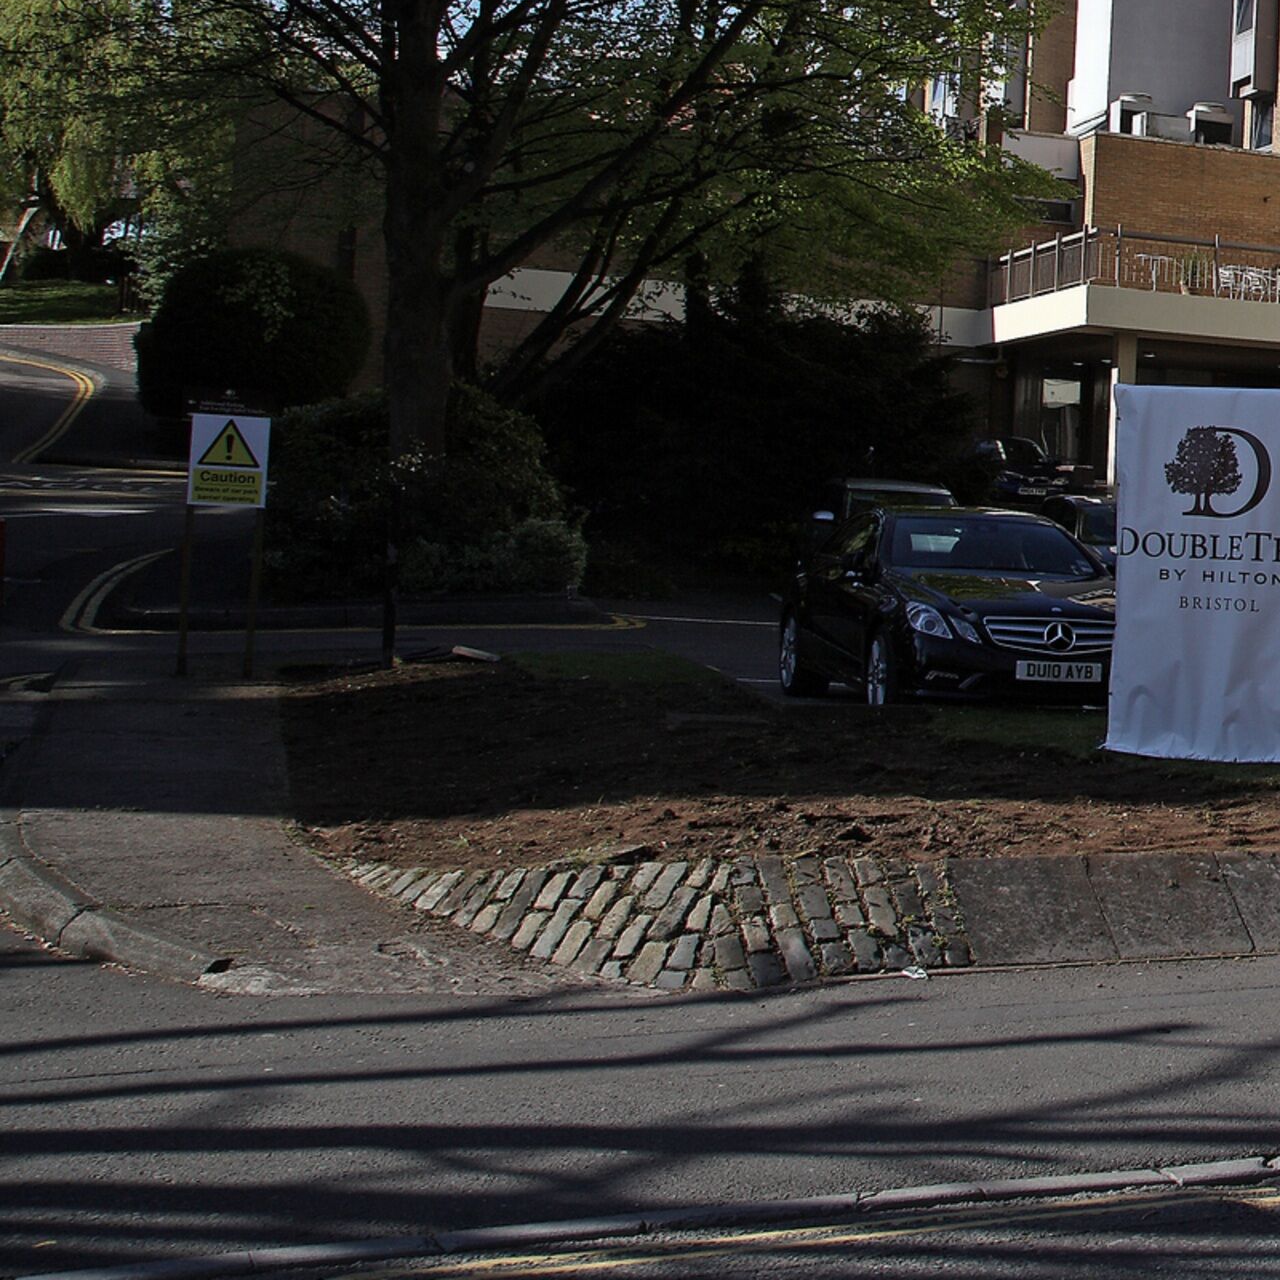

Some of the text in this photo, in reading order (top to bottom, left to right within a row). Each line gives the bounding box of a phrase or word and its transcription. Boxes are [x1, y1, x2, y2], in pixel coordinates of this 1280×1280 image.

[200, 470, 256, 484] Caution
[1159, 569, 1185, 581] BY
[1179, 596, 1260, 613] BRISTOL
[1026, 663, 1094, 679] DU10 AYB
